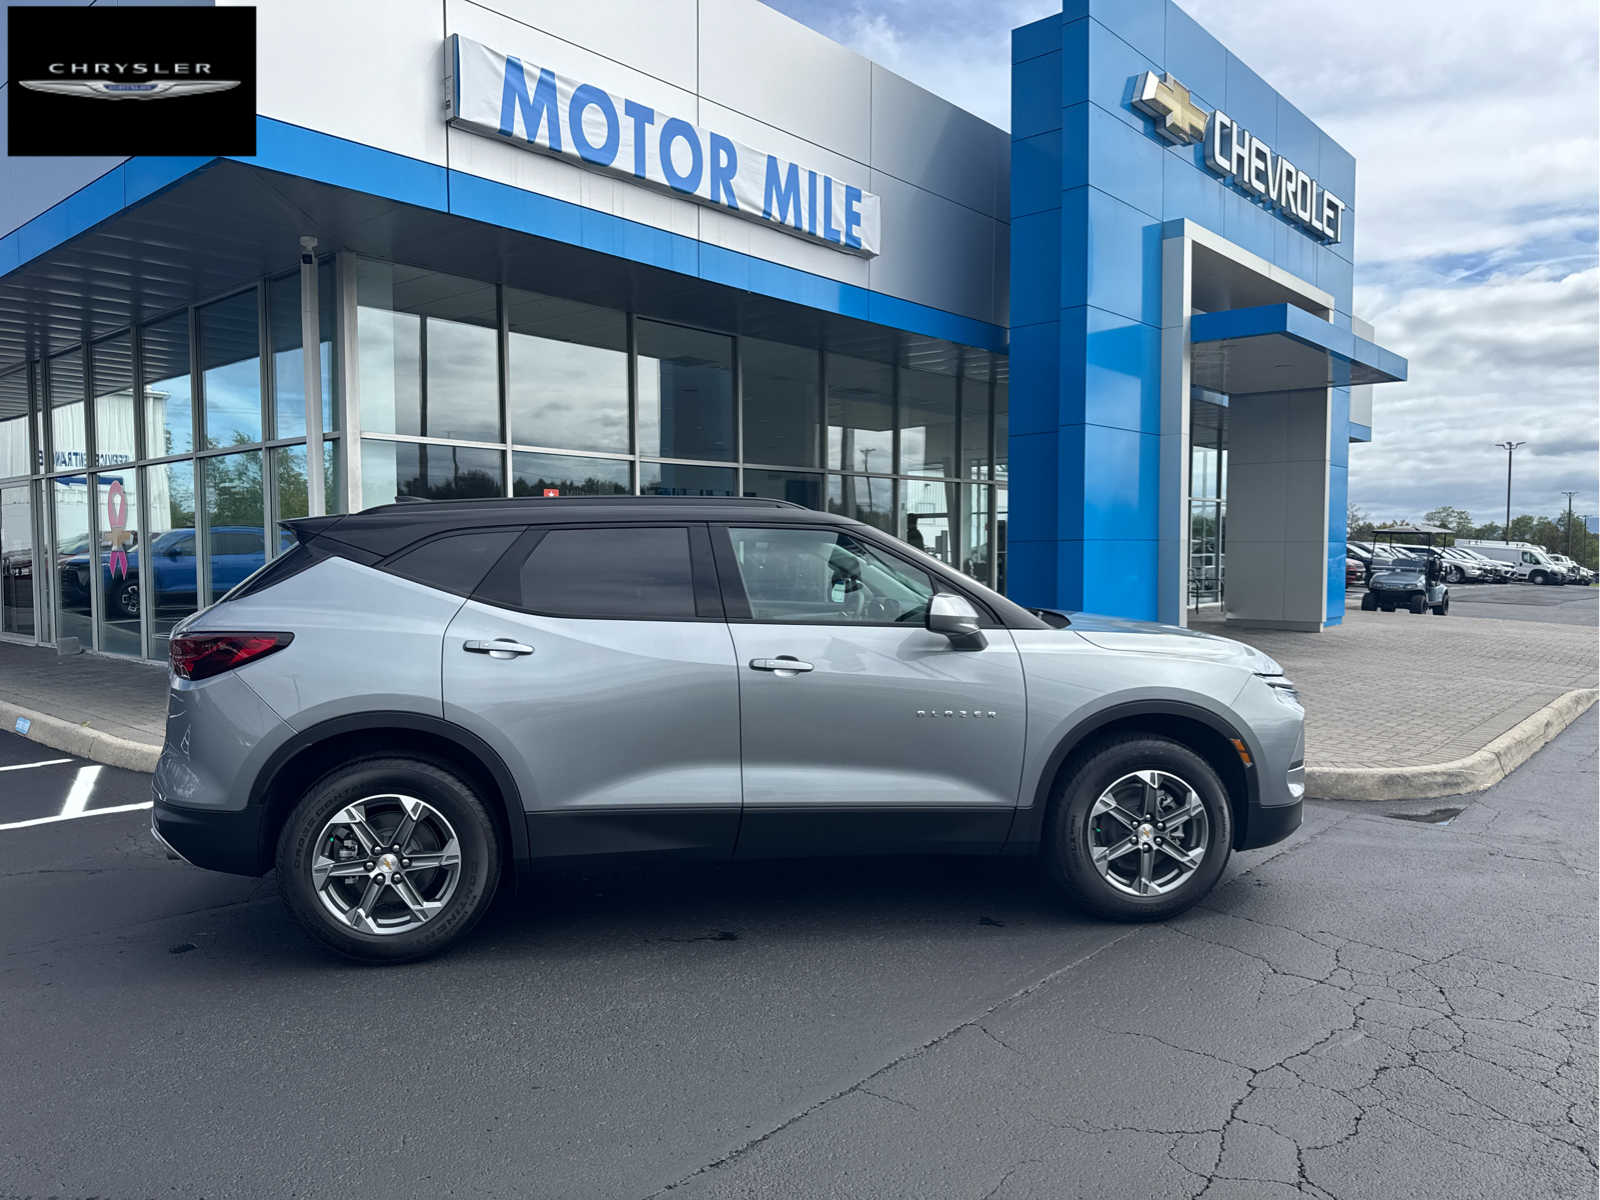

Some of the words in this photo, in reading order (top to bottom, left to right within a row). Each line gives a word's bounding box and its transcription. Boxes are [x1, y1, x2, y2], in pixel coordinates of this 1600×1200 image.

[498, 55, 739, 210] MOTOR
[762, 154, 863, 249] MILE
[1212, 109, 1346, 243] CHEVROLET
[916, 710, 998, 720] BLAZER
